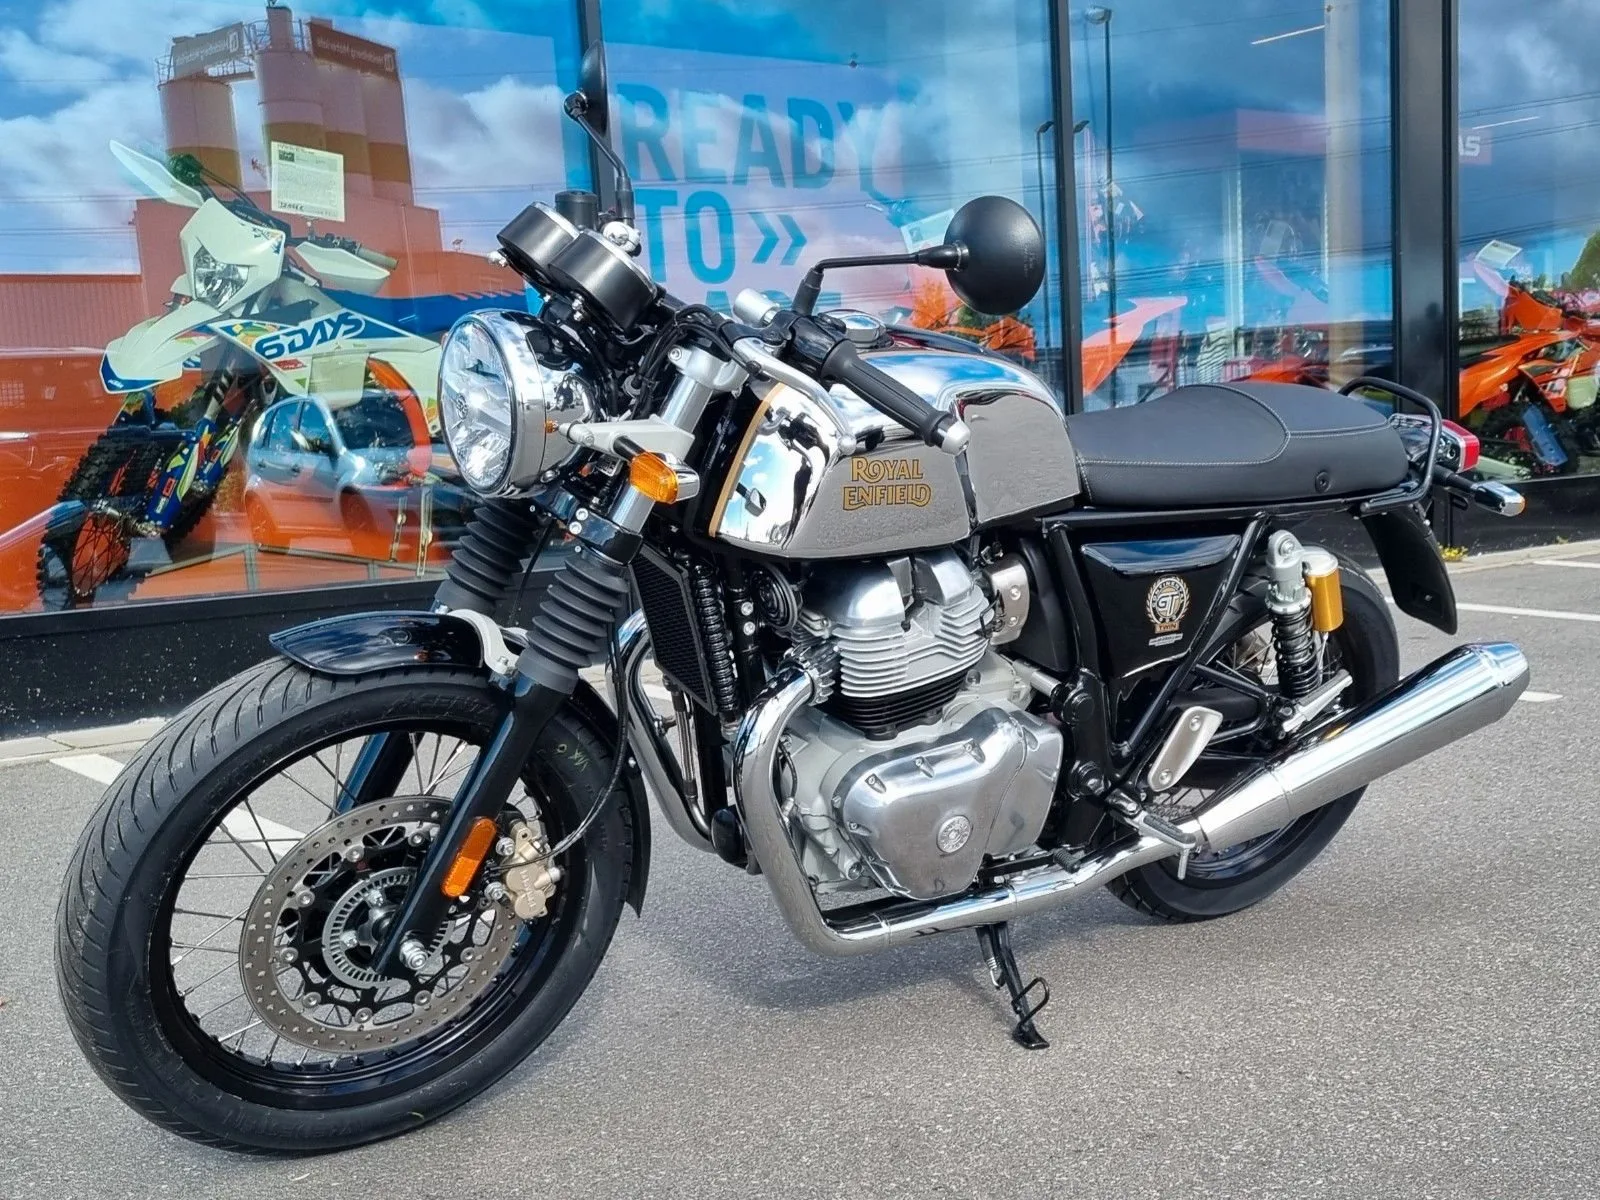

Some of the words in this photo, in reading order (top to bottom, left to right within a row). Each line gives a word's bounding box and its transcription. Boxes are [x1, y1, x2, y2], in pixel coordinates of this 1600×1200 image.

[617, 83, 884, 191] READY
[634, 188, 736, 285] TO
[254, 311, 364, 360] 6DAYS
[851, 456, 924, 484] ROYAL
[843, 483, 932, 511] ENFIELD
[1157, 591, 1181, 617] GT
